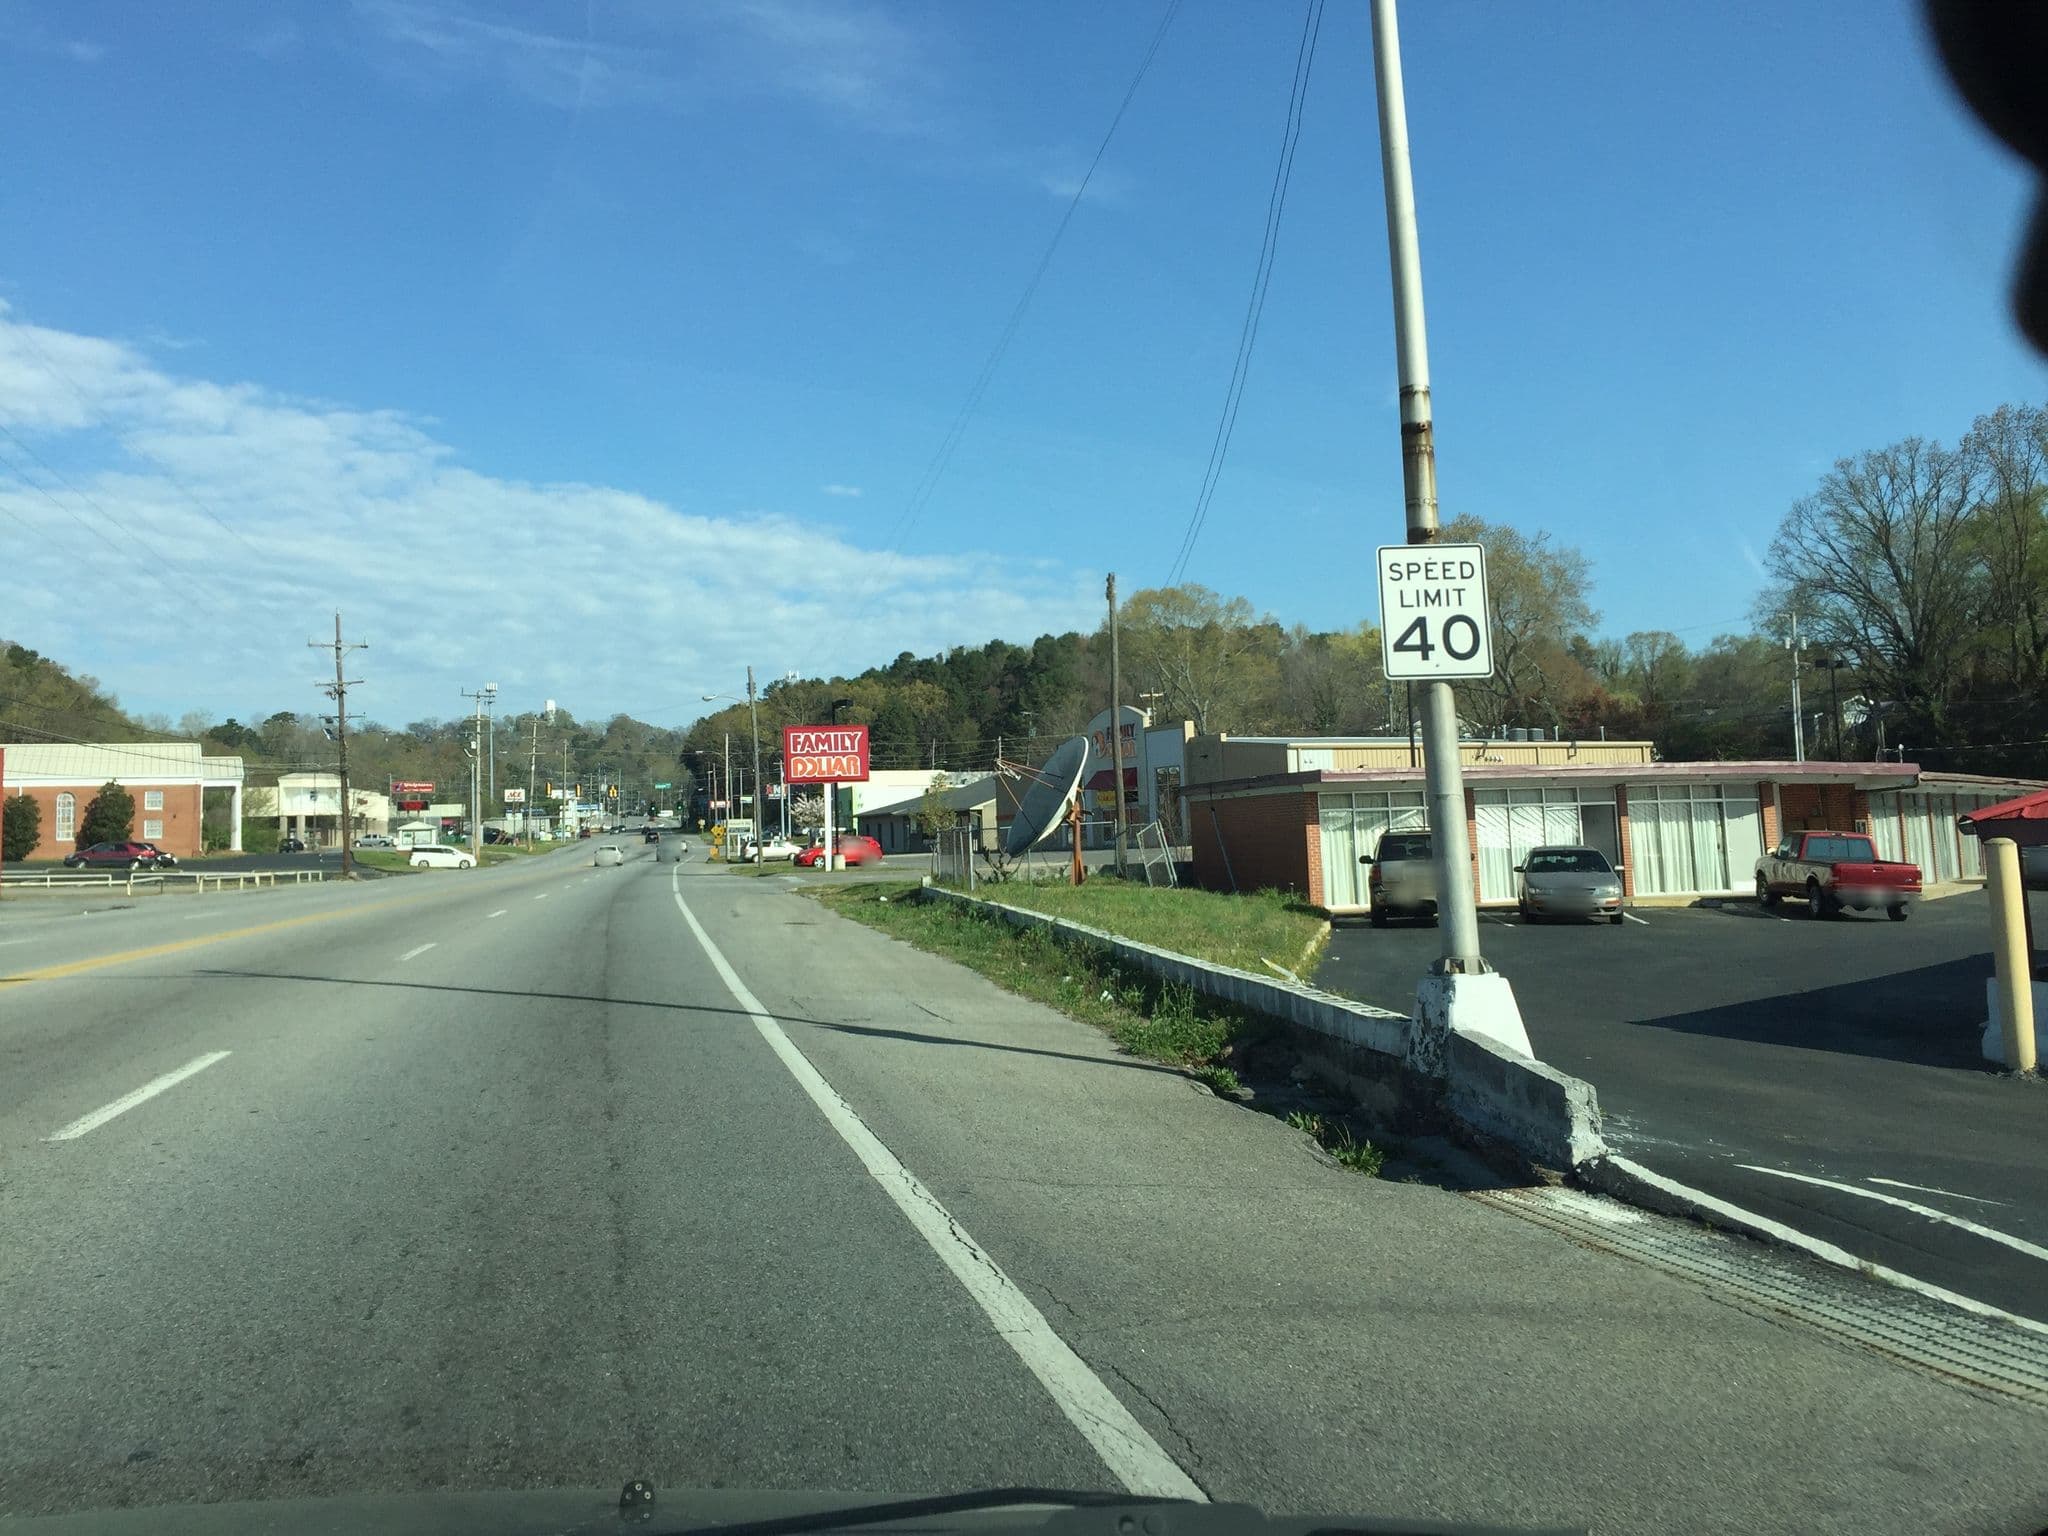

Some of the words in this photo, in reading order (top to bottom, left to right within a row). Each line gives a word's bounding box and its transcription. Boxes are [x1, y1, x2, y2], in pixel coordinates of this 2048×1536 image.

[1389, 561, 1475, 582] SPEED
[1400, 588, 1466, 608] LIMIT
[1393, 614, 1481, 661] 40
[790, 731, 863, 754] FAMILY
[790, 755, 861, 778] DOLLAR
